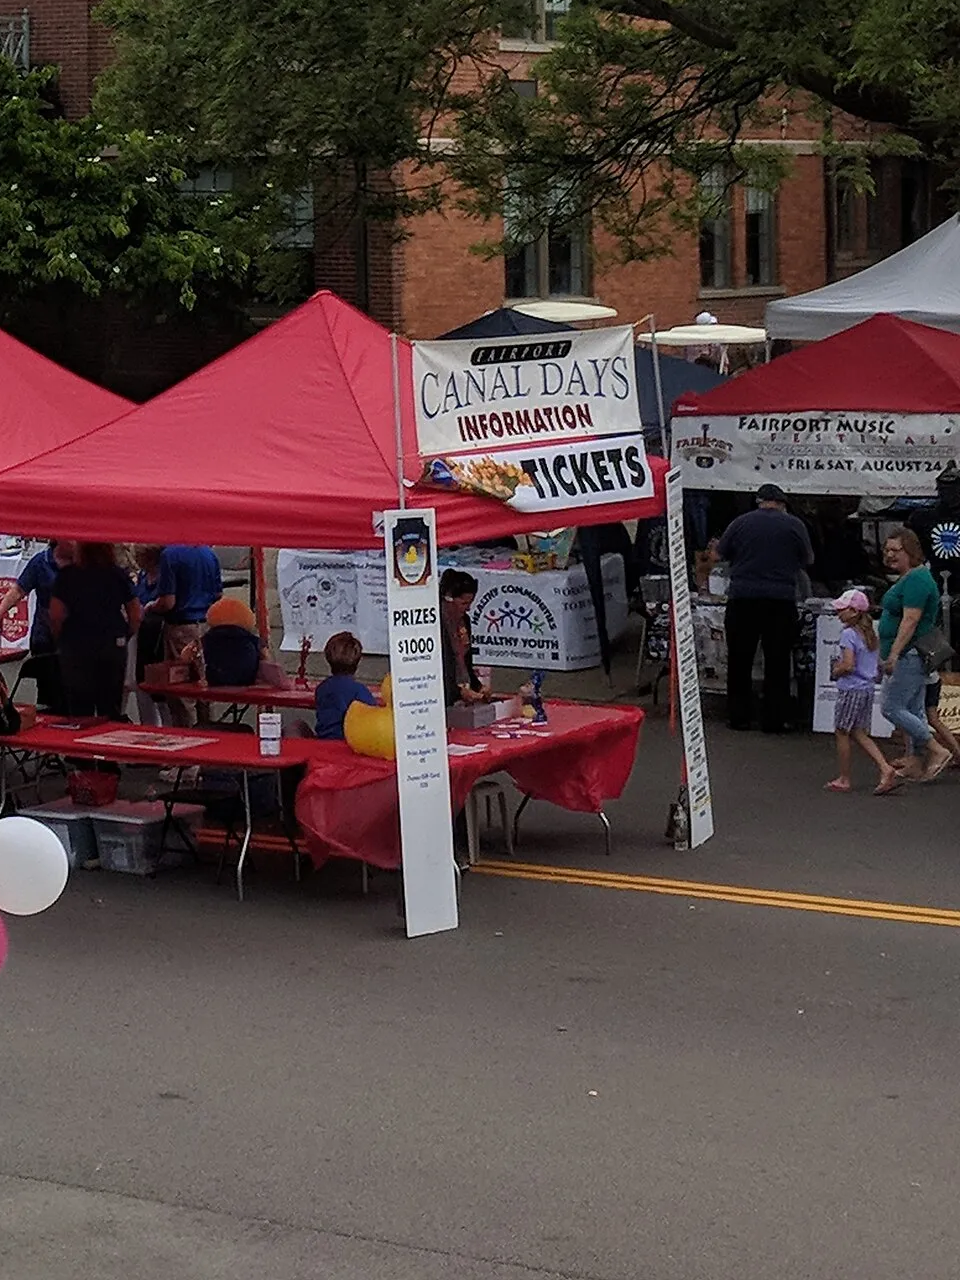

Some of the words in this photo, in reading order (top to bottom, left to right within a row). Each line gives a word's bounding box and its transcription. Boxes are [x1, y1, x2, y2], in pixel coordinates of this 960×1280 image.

[476, 342, 565, 363] FAIRPORT
[421, 364, 531, 419] CANAL
[537, 356, 630, 400] DAYS
[457, 403, 593, 442] INFORMATION
[738, 417, 831, 433] FAIRPORT
[836, 419, 895, 434] MUSIC
[520, 445, 646, 500] TICKETS
[788, 458, 810, 470] FRI
[814, 458, 824, 470] &
[861, 460, 922, 472] AUGUST
[393, 607, 437, 626] PRIZES
[471, 587, 498, 626] HEALTHY
[501, 585, 558, 631] COMMUNITIES
[398, 637, 434, 654] $1000
[471, 635, 520, 647] HEALTHY
[521, 638, 559, 650] YOUTH
